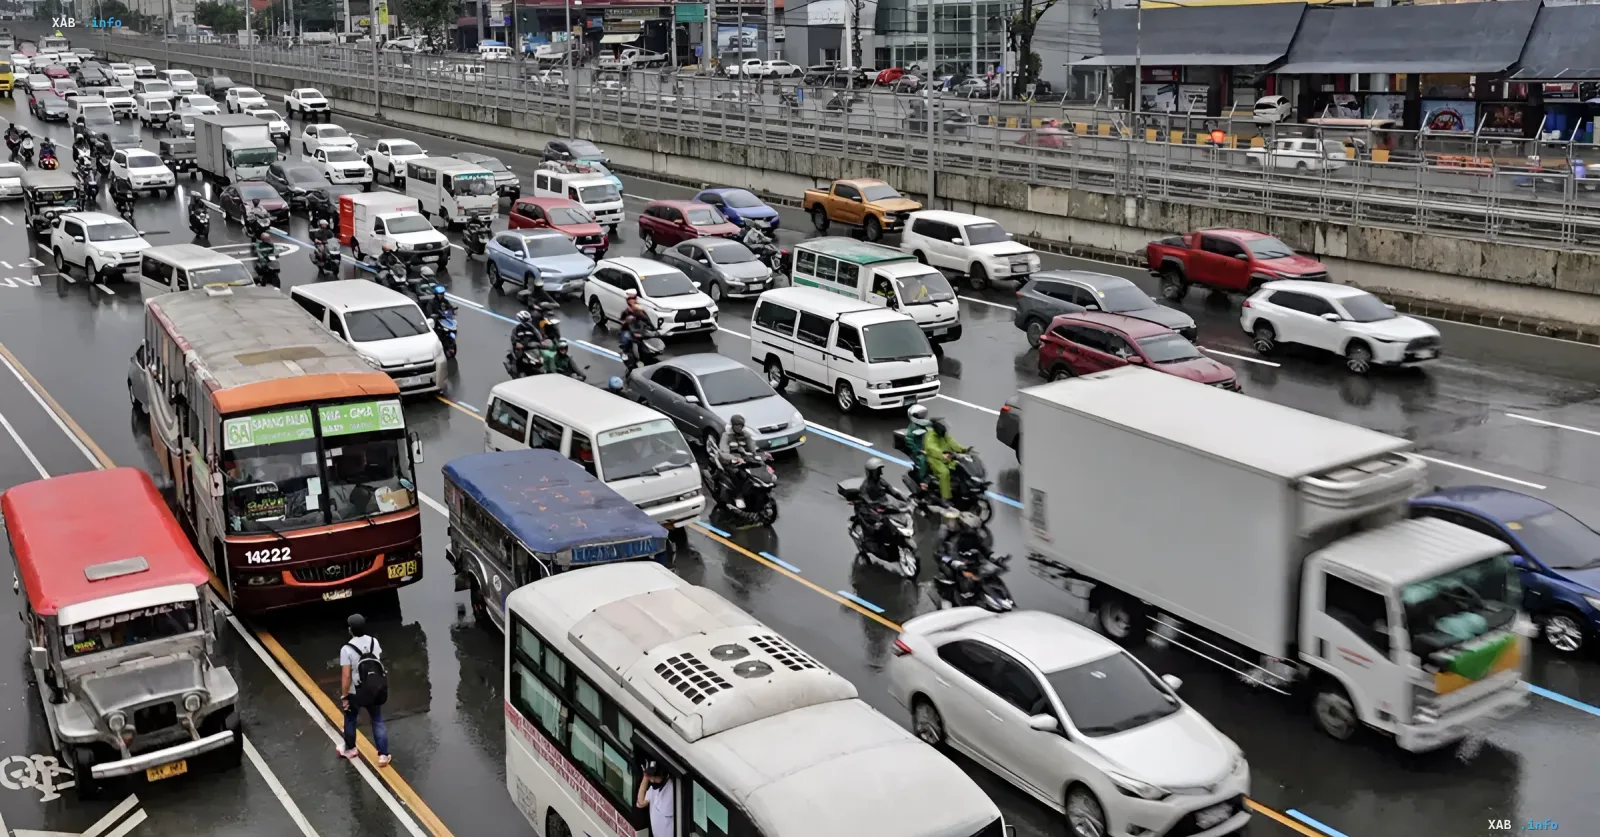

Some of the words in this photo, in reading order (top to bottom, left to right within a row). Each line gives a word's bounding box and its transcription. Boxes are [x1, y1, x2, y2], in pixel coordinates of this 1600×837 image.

[381, 406, 400, 424] 6A
[229, 423, 250, 442] 6A
[245, 546, 292, 564] 14222
